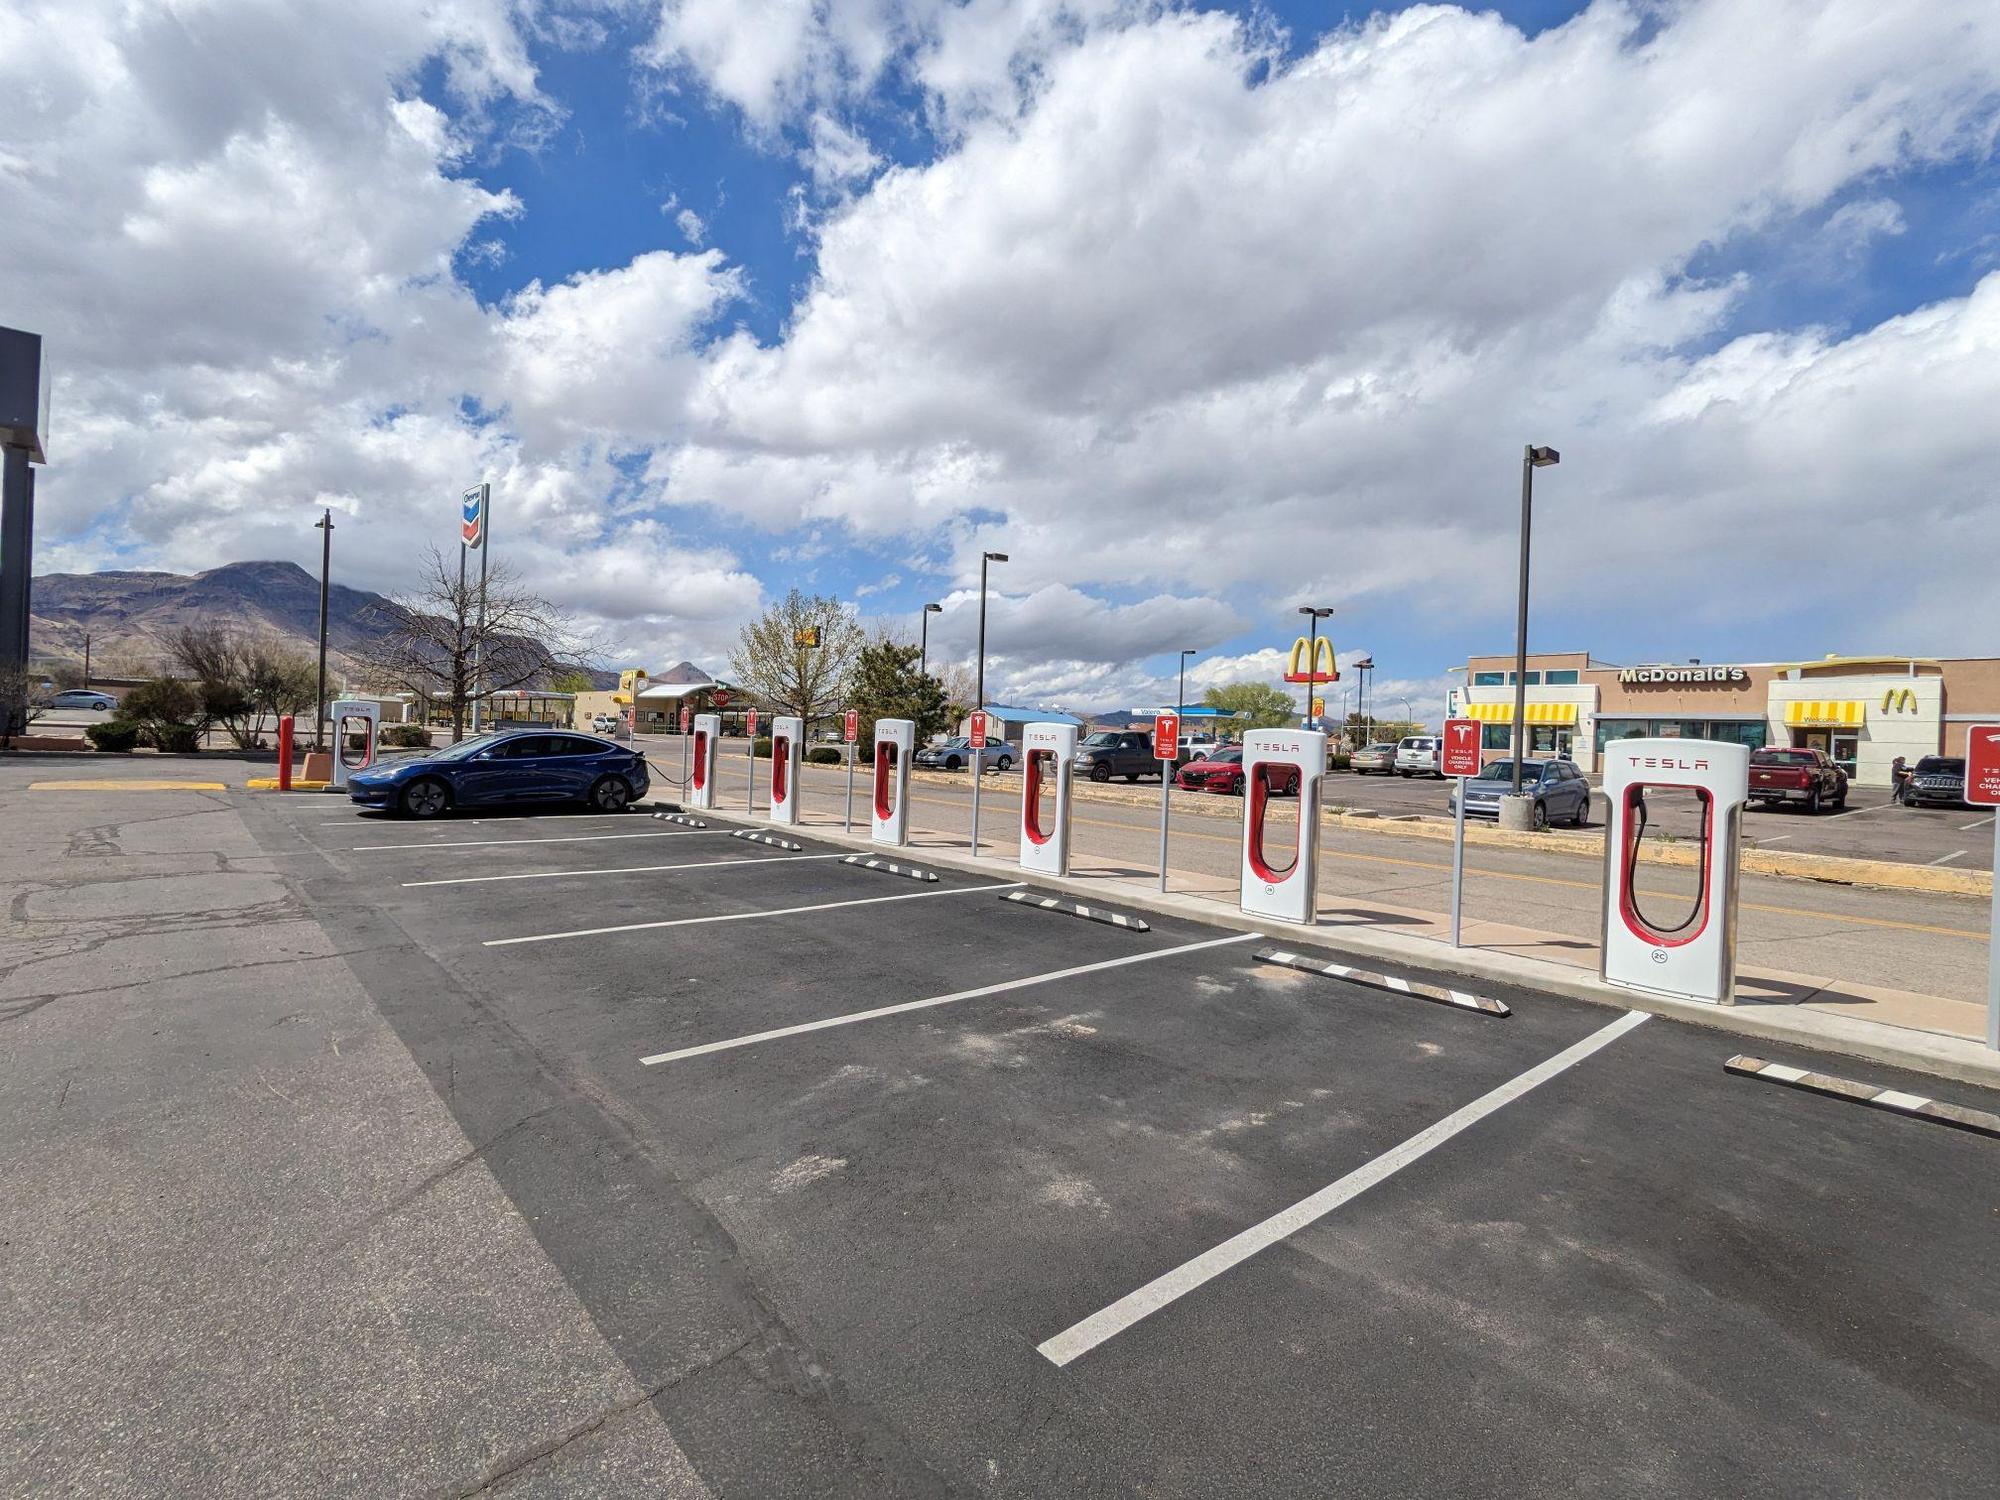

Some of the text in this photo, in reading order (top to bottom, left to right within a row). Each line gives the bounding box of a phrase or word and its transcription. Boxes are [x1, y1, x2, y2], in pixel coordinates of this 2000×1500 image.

[1619, 667, 1744, 683] McDonald's
[713, 693, 728, 702] STOP
[1028, 733, 1057, 741] TESLA
[1254, 743, 1300, 753] TESLA
[1628, 757, 1709, 771] TESLA
[1654, 952, 1665, 960] 2C
